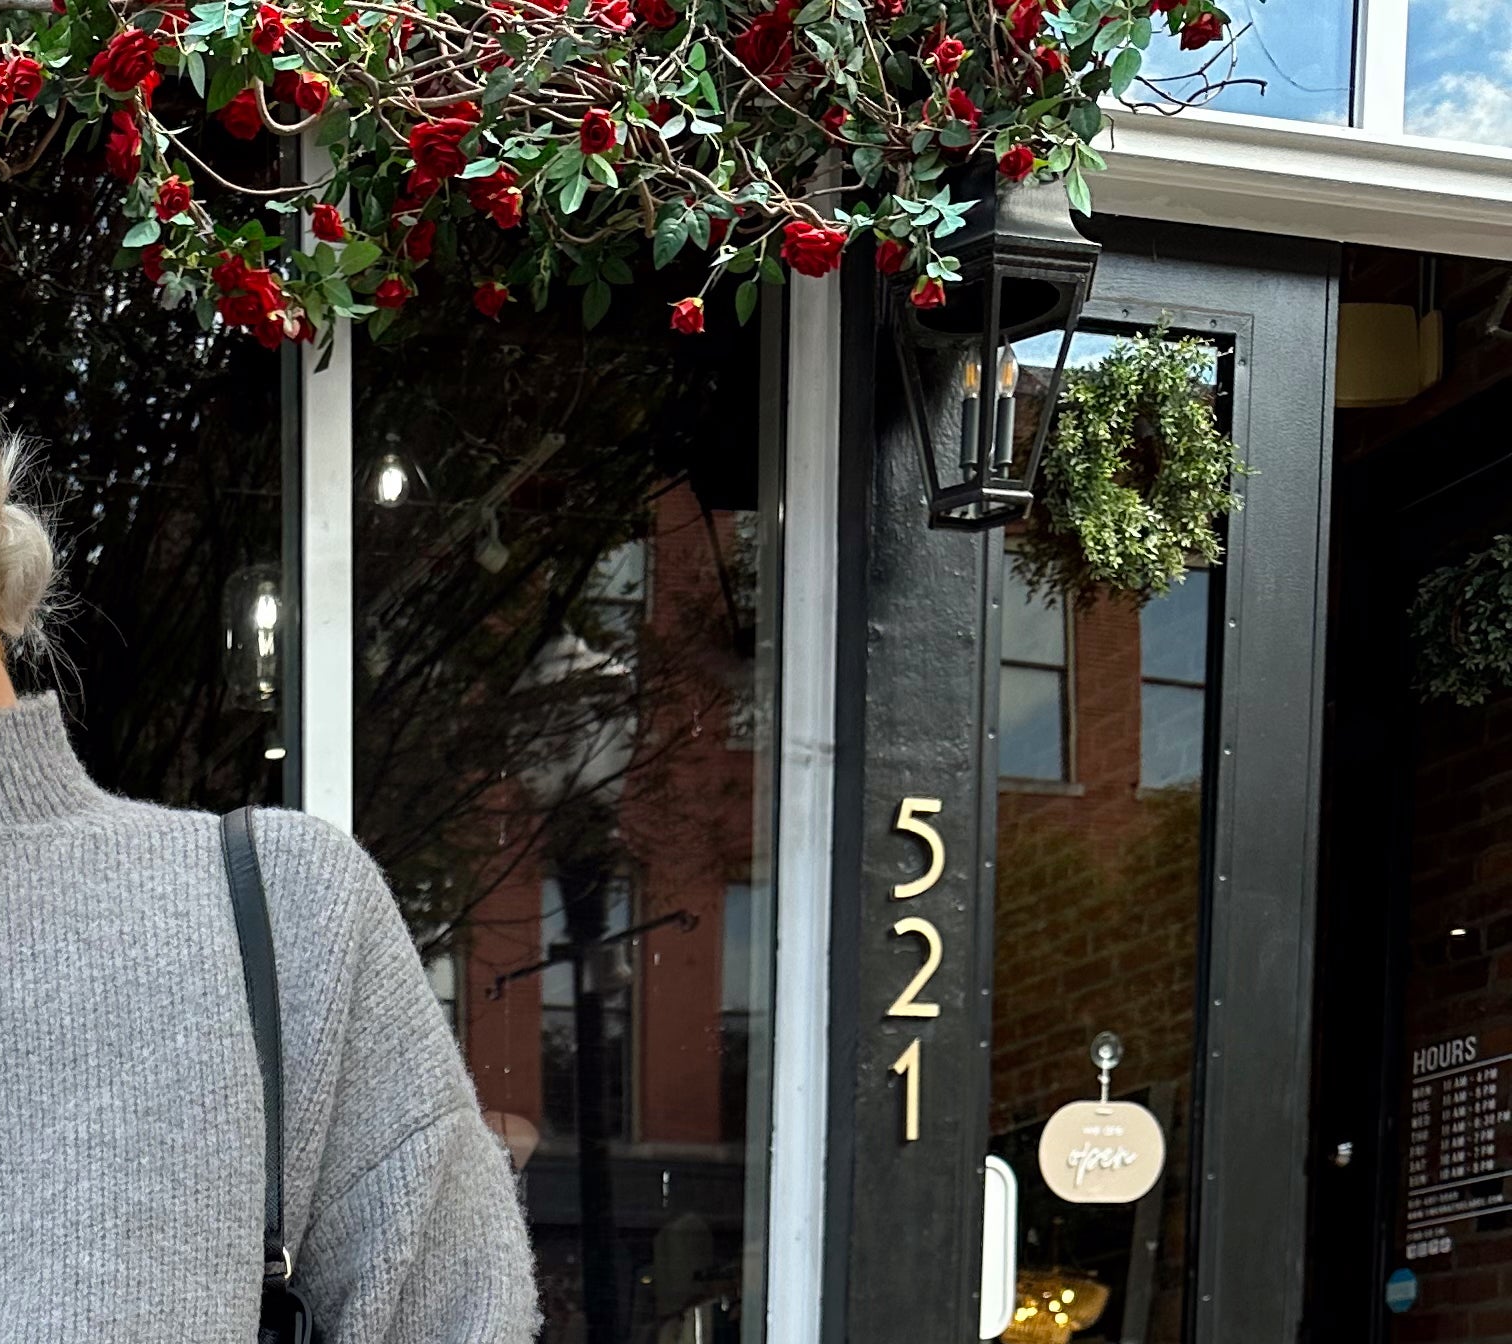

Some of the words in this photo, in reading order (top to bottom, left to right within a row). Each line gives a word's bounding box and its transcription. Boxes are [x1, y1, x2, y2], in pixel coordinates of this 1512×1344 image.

[886, 797, 945, 1141] 521
[1413, 1036, 1477, 1075] HOURS
[1067, 1140, 1137, 1187] open
